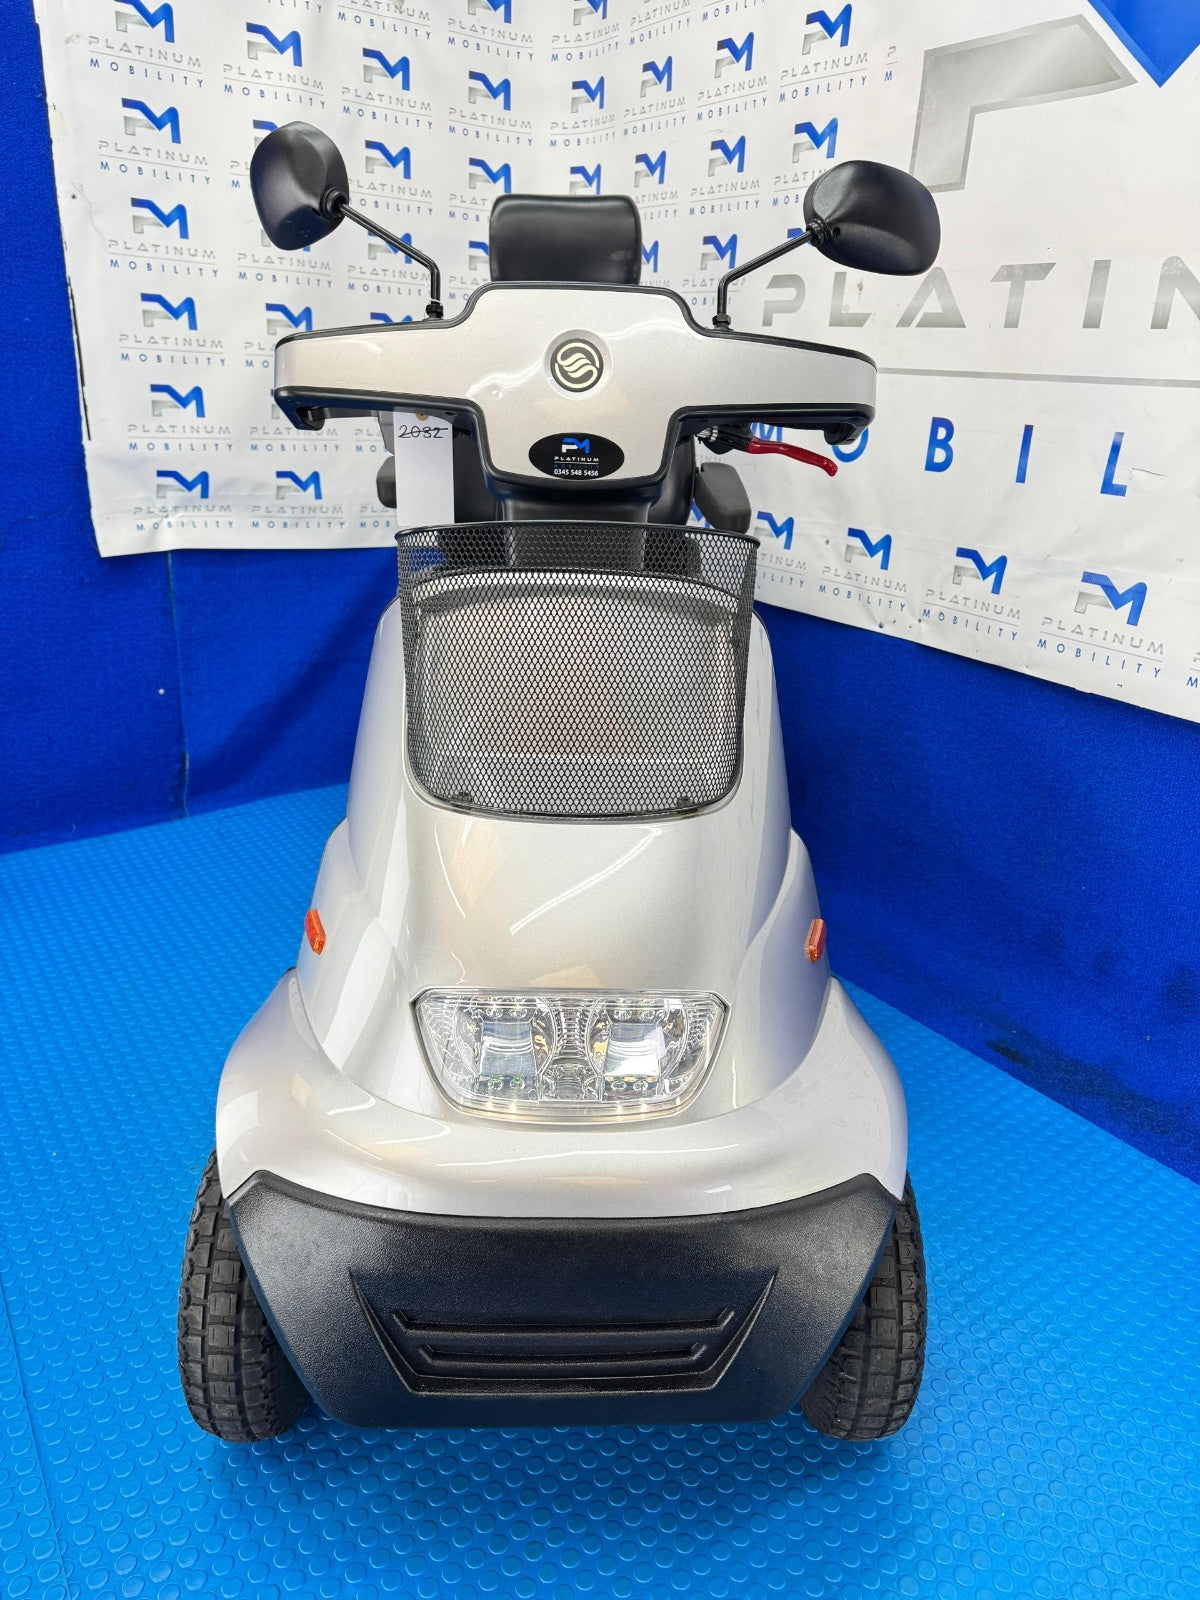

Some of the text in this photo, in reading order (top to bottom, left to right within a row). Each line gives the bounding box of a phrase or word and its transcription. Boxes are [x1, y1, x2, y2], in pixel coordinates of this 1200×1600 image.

[350, 0, 430, 21] ATINUM
[338, 11, 431, 39] MOBILITY
[448, 18, 533, 43] PLATINUM
[552, 23, 620, 44] PLATINUM
[630, 17, 691, 45] MOBILITY
[88, 36, 202, 68] PLATINUM
[448, 36, 534, 61] MOBILITY
[551, 41, 619, 62] MOBILITY
[89, 58, 203, 88] MOBILITY
[223, 63, 324, 90] PLATINUM
[780, 52, 868, 81] PLATINUM
[224, 83, 325, 108] MOBILITY
[342, 86, 432, 111] PLATINUM
[698, 75, 768, 101] PLATINUM
[779, 75, 867, 102] MOBILITY
[342, 105, 433, 130] MOBILITY
[449, 107, 532, 129] PLATINUM
[624, 96, 686, 119] PLATINUM
[696, 97, 767, 121] MOBILITY
[550, 114, 615, 130] PLATINUM
[623, 116, 686, 136] MOBILITY
[449, 125, 533, 146] MOBILITY
[550, 132, 615, 147] MOBILITY
[98, 140, 208, 166] PLATINUM
[100, 161, 210, 185] MOBILITY
[635, 190, 678, 204] ATINUM
[690, 179, 760, 197] PLATINUM
[350, 197, 433, 216] OBILITY
[644, 209, 678, 220] ILITY
[689, 199, 760, 216] MOBILITY
[108, 239, 216, 259] PLATINUM
[110, 259, 218, 278] MOBILITY
[238, 252, 331, 271] PLATINUM
[238, 271, 332, 288] MOBILITY
[348, 282, 431, 297] MOBILIT
[119, 333, 224, 349] PLATINUM
[120, 352, 226, 367] MOBILITY
[127, 424, 231, 434] PLATINUM
[129, 442, 233, 451] MOBILITY
[250, 444, 340, 452] MOBILITY
[133, 504, 232, 514] PLATINUM
[251, 505, 344, 514] PLATINUM
[136, 520, 234, 532] MOBILITY
[251, 521, 345, 529] MOBILITY
[759, 552, 807, 570] TINUM
[763, 572, 805, 588] ILITY
[822, 565, 908, 593] PLATINUM
[818, 584, 906, 612] MOBILITY
[925, 588, 1021, 620] PLATINUM
[922, 608, 1019, 641] MOBILITY
[1041, 616, 1165, 655] PLATINUM
[1036, 638, 1161, 678] MOBILITY
